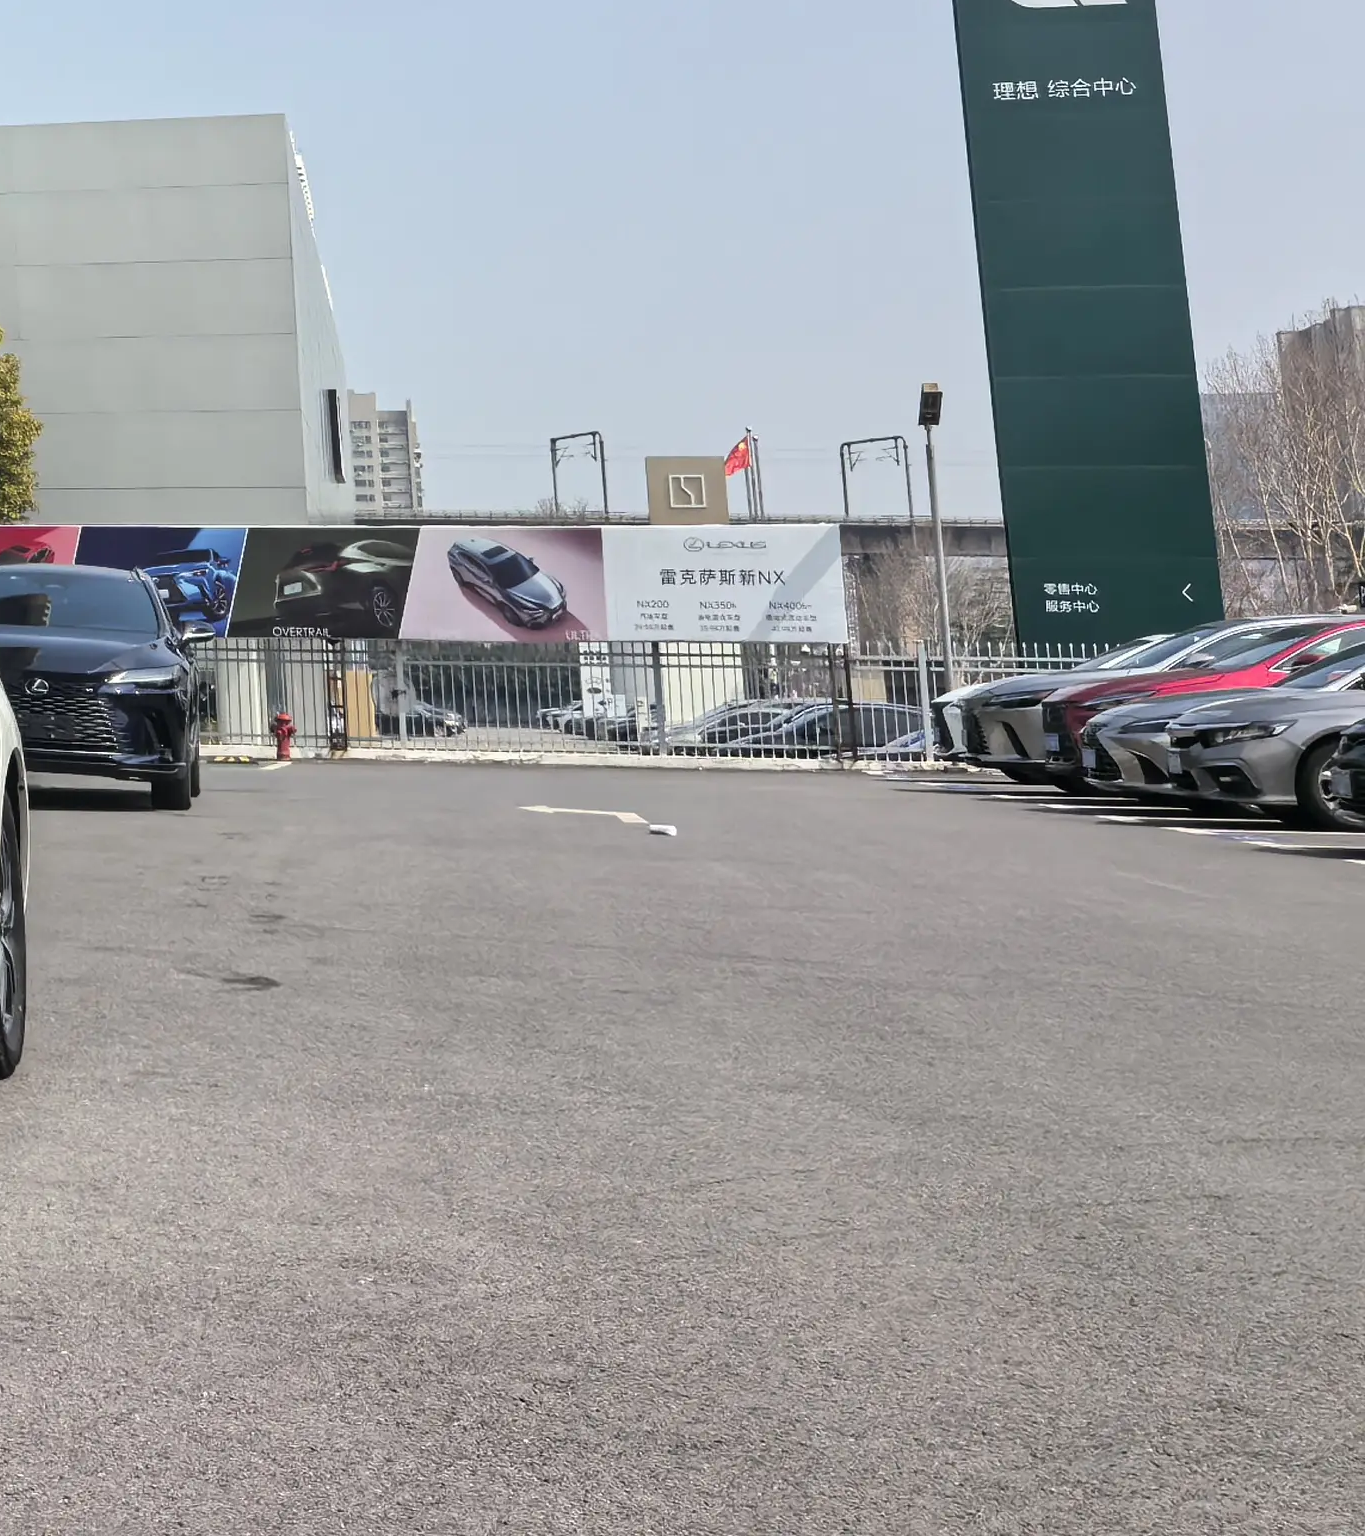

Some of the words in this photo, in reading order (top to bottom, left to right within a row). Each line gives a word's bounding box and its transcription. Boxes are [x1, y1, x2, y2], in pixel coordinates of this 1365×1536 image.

[992, 80, 1039, 101] 理想
[1047, 76, 1137, 98] 综合中心
[706, 540, 767, 550] LEXUS
[659, 568, 786, 586] 雷克萨斯新NX
[1043, 582, 1098, 595] 零售中心
[636, 599, 670, 609] NX200
[1045, 600, 1100, 613] 服务中心
[272, 626, 331, 638] OVERTRAIL
